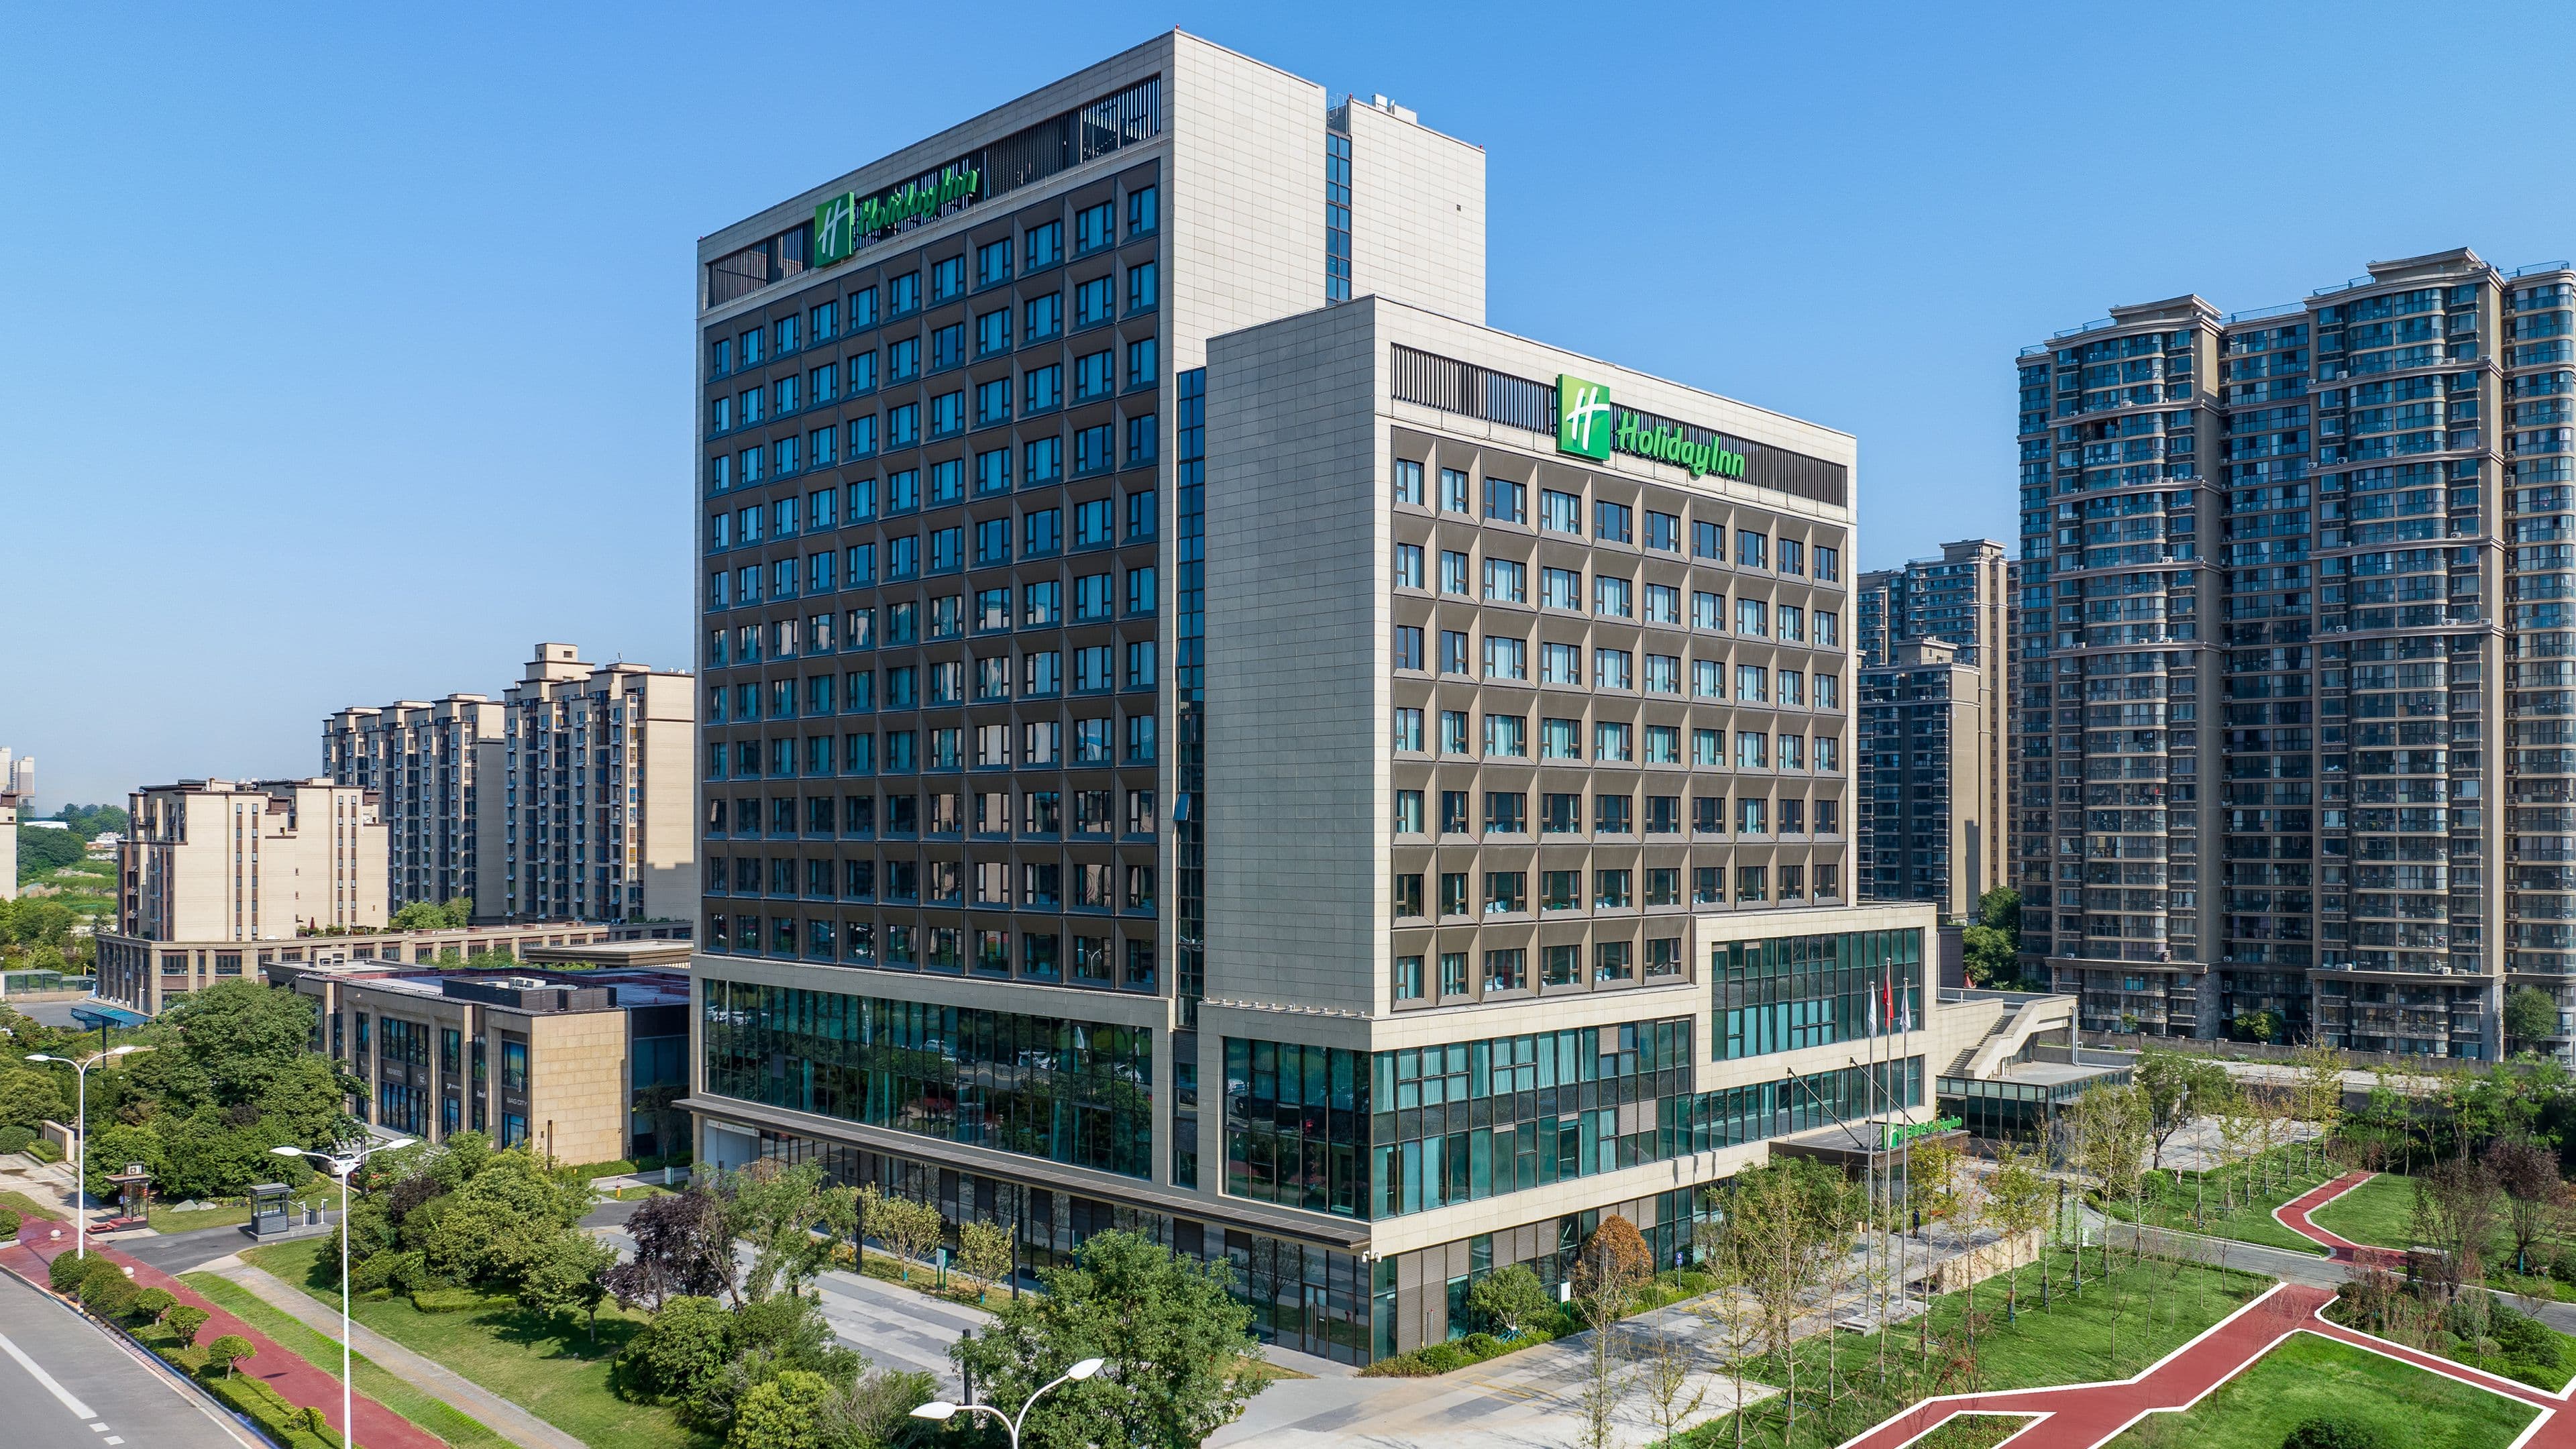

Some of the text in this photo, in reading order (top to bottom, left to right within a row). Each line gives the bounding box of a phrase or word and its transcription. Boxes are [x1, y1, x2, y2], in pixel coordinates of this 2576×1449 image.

[859, 167, 977, 235] Holiday Inn
[1616, 411, 1745, 478] Holiday Inn
